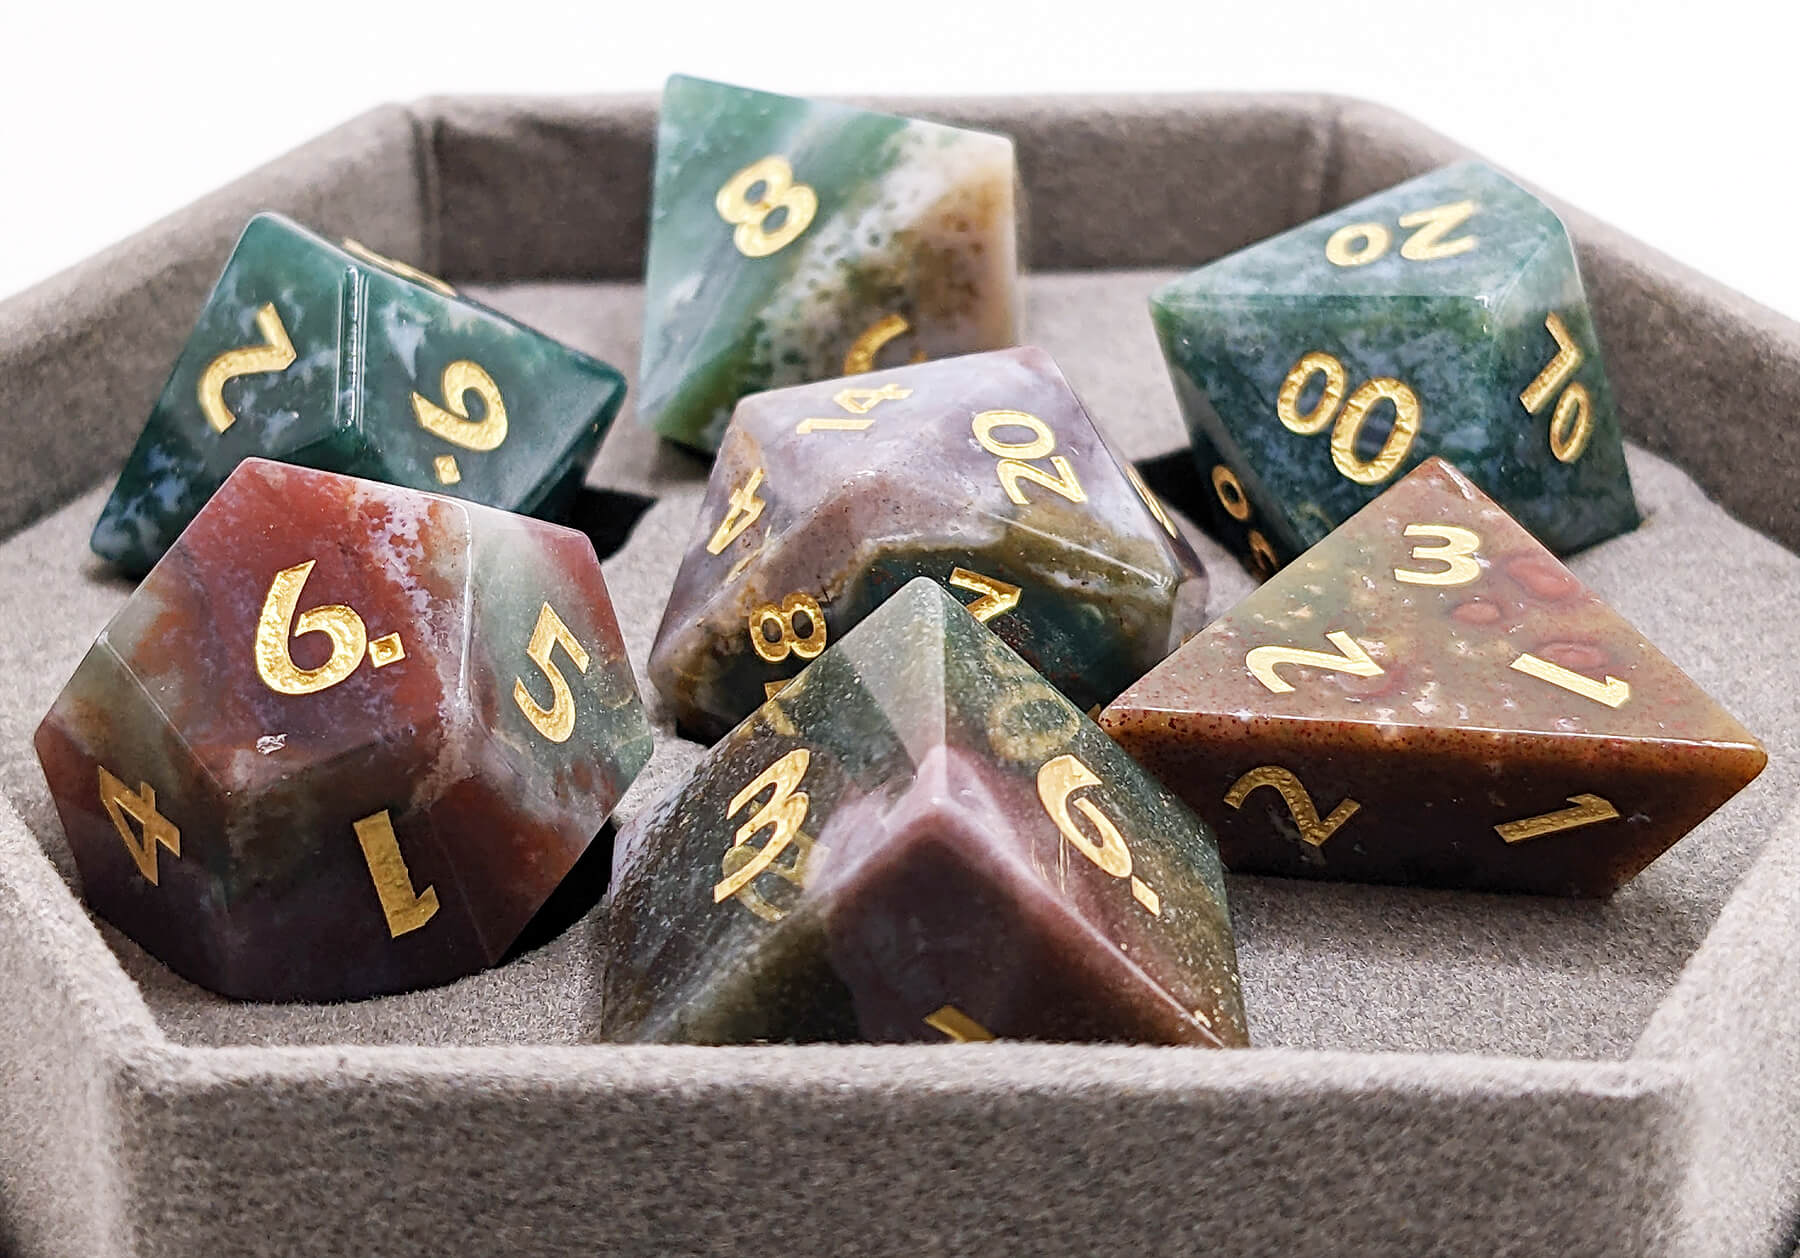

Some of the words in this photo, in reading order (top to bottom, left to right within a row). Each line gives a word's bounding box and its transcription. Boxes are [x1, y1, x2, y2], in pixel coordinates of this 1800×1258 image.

[715, 156, 818, 257] 8
[796, 383, 914, 434] 14
[1276, 350, 1422, 486] 00
[971, 409, 1088, 505] 20
[706, 466, 766, 556] 4
[1394, 523, 1484, 586] 3
[514, 601, 590, 743] 5
[1245, 630, 1385, 693] 2
[1510, 652, 1631, 708] 1
[99, 765, 181, 886] 4
[714, 747, 810, 904] 3
[1223, 765, 1361, 846] 2
[1494, 793, 1621, 843] 1
[353, 809, 440, 939] 1
